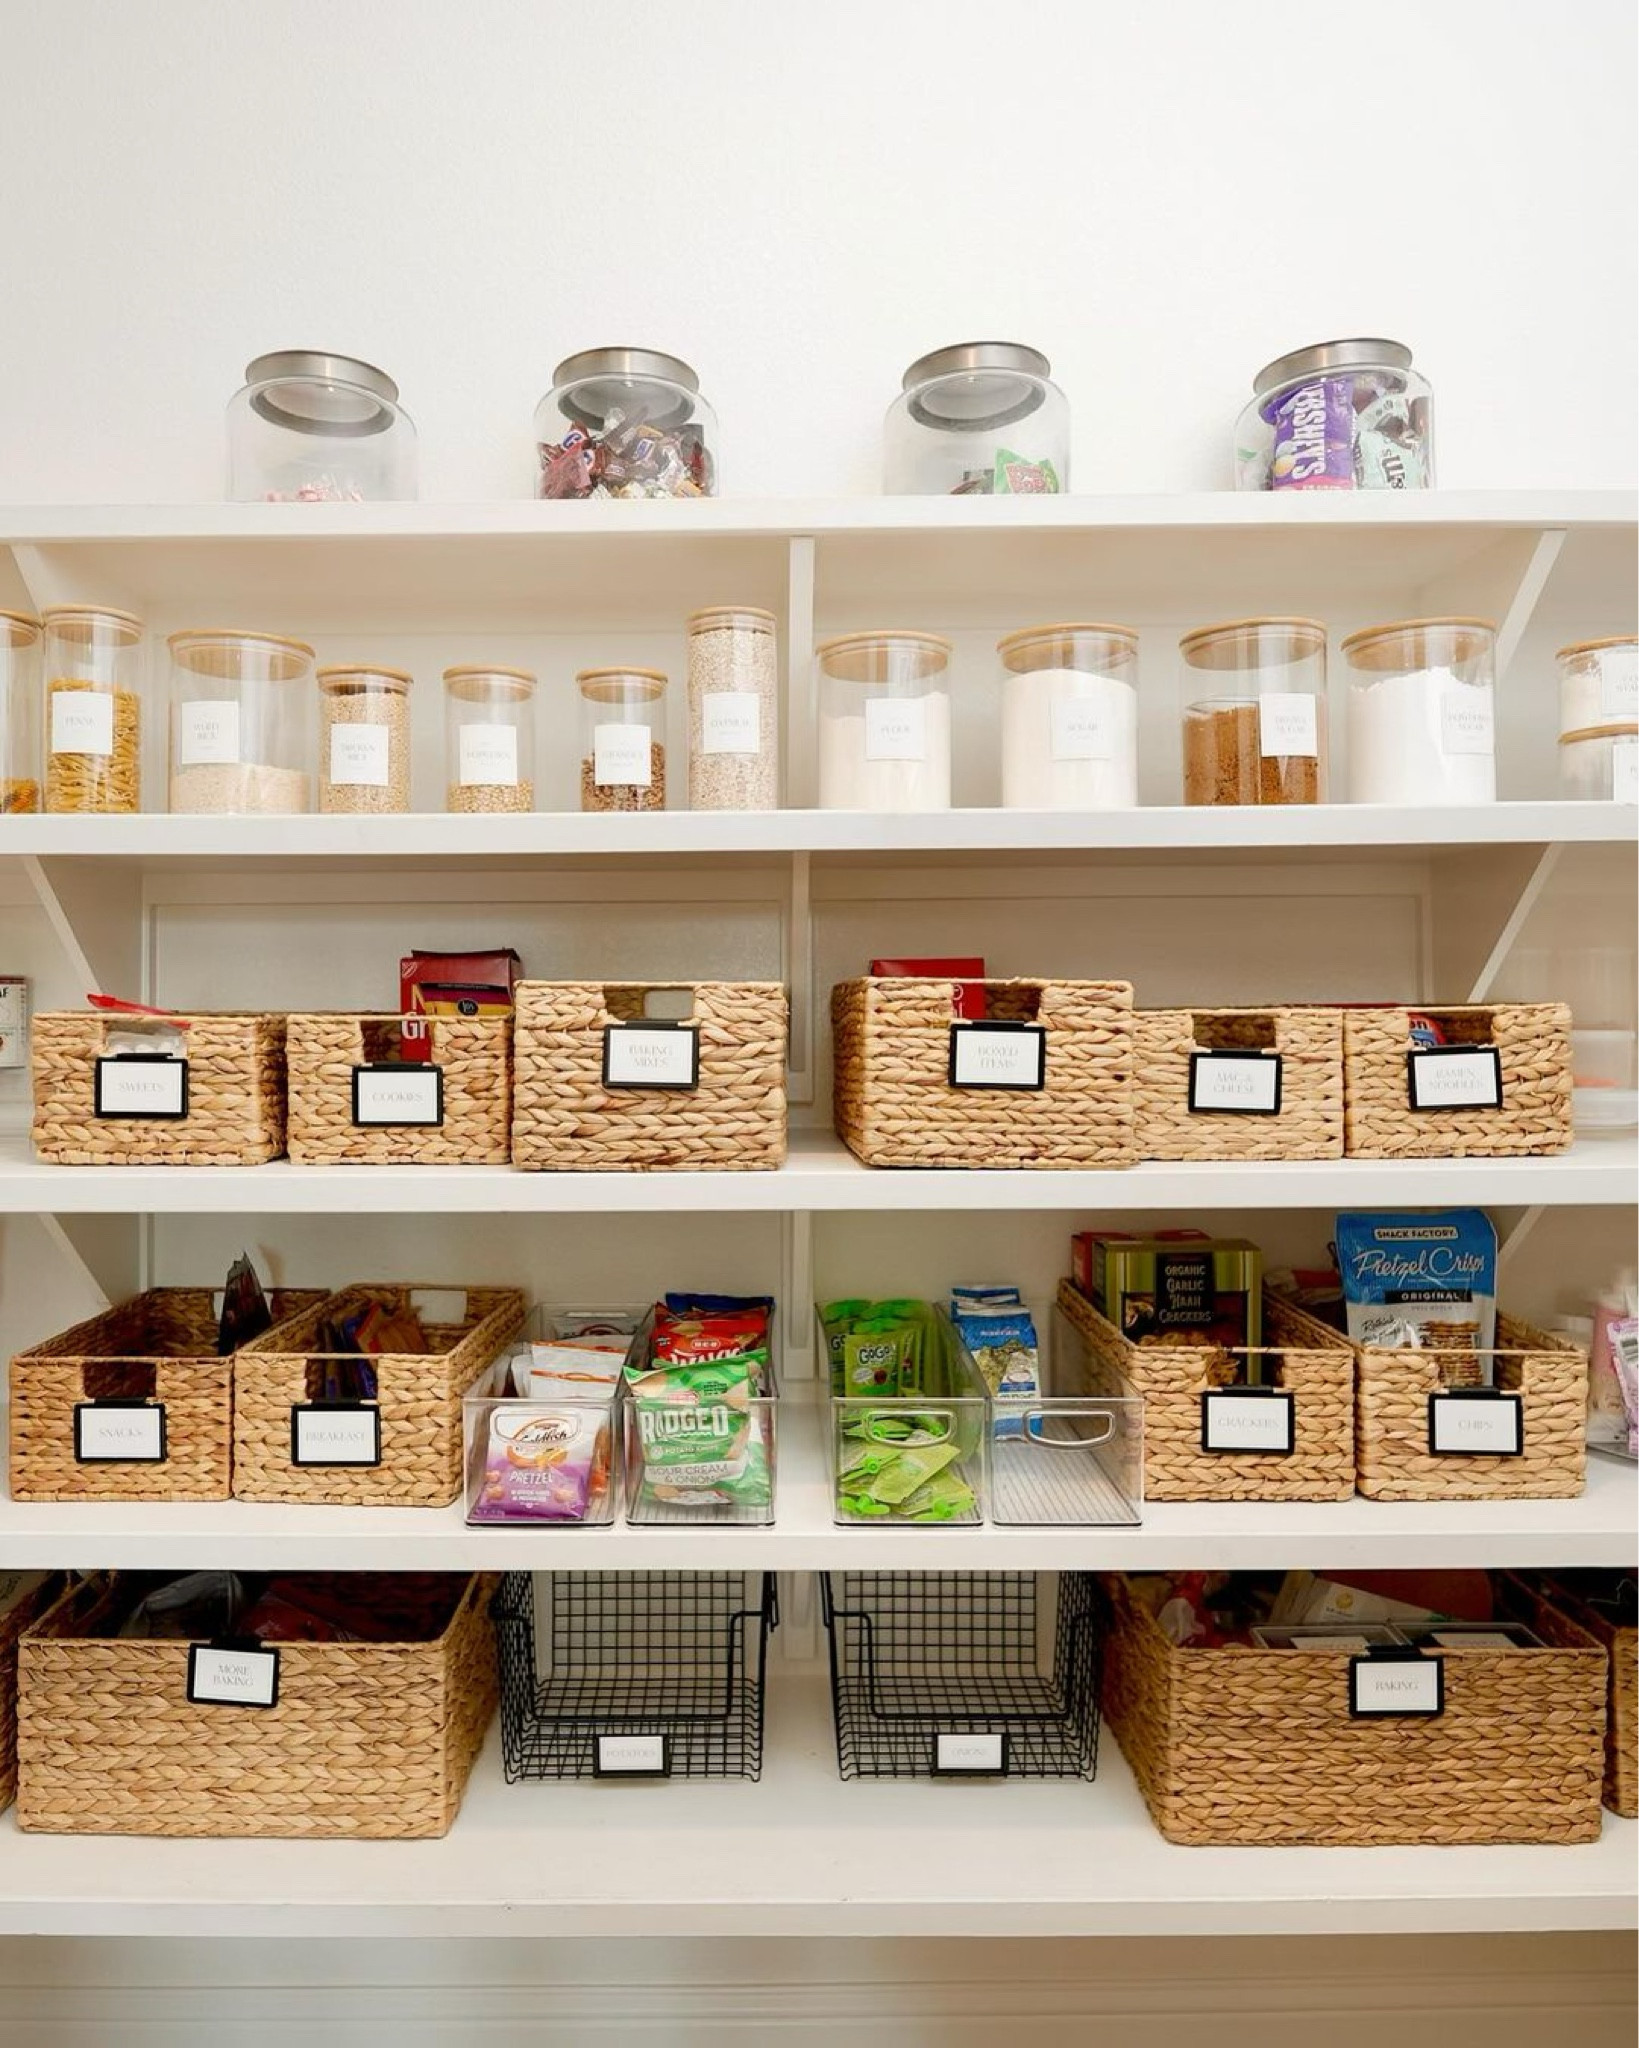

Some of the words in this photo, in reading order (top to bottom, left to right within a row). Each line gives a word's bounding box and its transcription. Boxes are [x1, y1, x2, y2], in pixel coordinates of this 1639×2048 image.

[628, 1045, 673, 1056] BAKING
[977, 1046, 1019, 1057] BOXED
[632, 1056, 669, 1067] MIXES
[980, 1058, 1014, 1069] ITEMS
[1435, 1067, 1475, 1079] RAMEN
[117, 1081, 165, 1092] SWEETS
[1213, 1083, 1255, 1094] CHEESE
[1429, 1078, 1485, 1091] NOODLES
[372, 1091, 424, 1102] COOKIES
[1376, 1231, 1409, 1239] SNACK
[1165, 1265, 1206, 1276] ORGANIC
[1352, 1250, 1427, 1287] Pretzel
[1429, 1247, 1485, 1279] Crisps
[1166, 1278, 1205, 1293] GARLIC
[1401, 1291, 1460, 1300] ORIGINAL
[1158, 1309, 1212, 1324] CRACKERS
[1217, 1417, 1281, 1429] CRACKERS
[1458, 1419, 1494, 1430] CHIPS
[98, 1427, 144, 1437] SNACKS
[305, 1430, 366, 1442] BREAKFAST
[648, 1466, 682, 1476] SOUR
[685, 1463, 729, 1475] CREAM
[509, 1471, 553, 1485] PRETZEL
[217, 1663, 250, 1676] MORE
[212, 1675, 254, 1687] BAKING
[1375, 1680, 1419, 1692] BAKING
[605, 1748, 657, 1758] POTATOES
